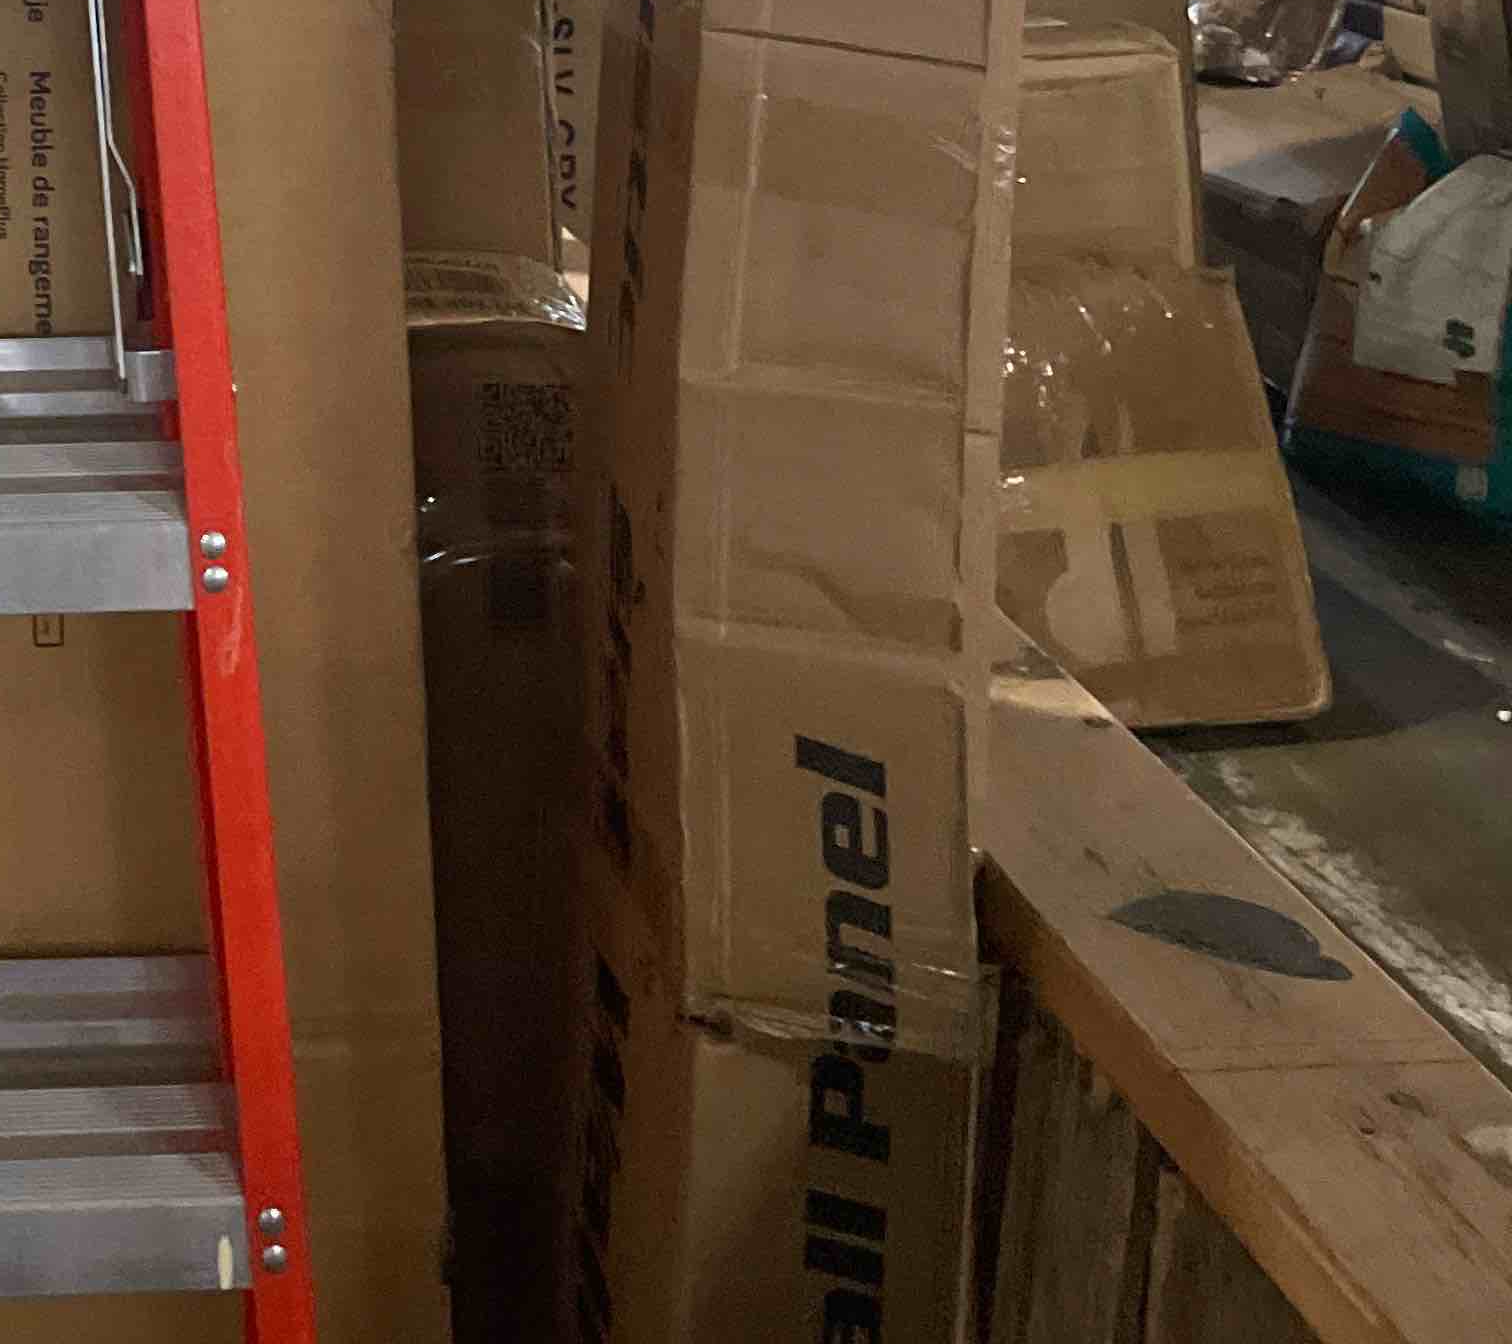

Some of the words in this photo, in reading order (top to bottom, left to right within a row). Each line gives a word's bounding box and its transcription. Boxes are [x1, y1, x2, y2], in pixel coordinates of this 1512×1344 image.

[28, 71, 55, 169] Meuble
[31, 176, 55, 209] de
[29, 216, 55, 338] rangeme
[793, 732, 898, 1164] Panel
